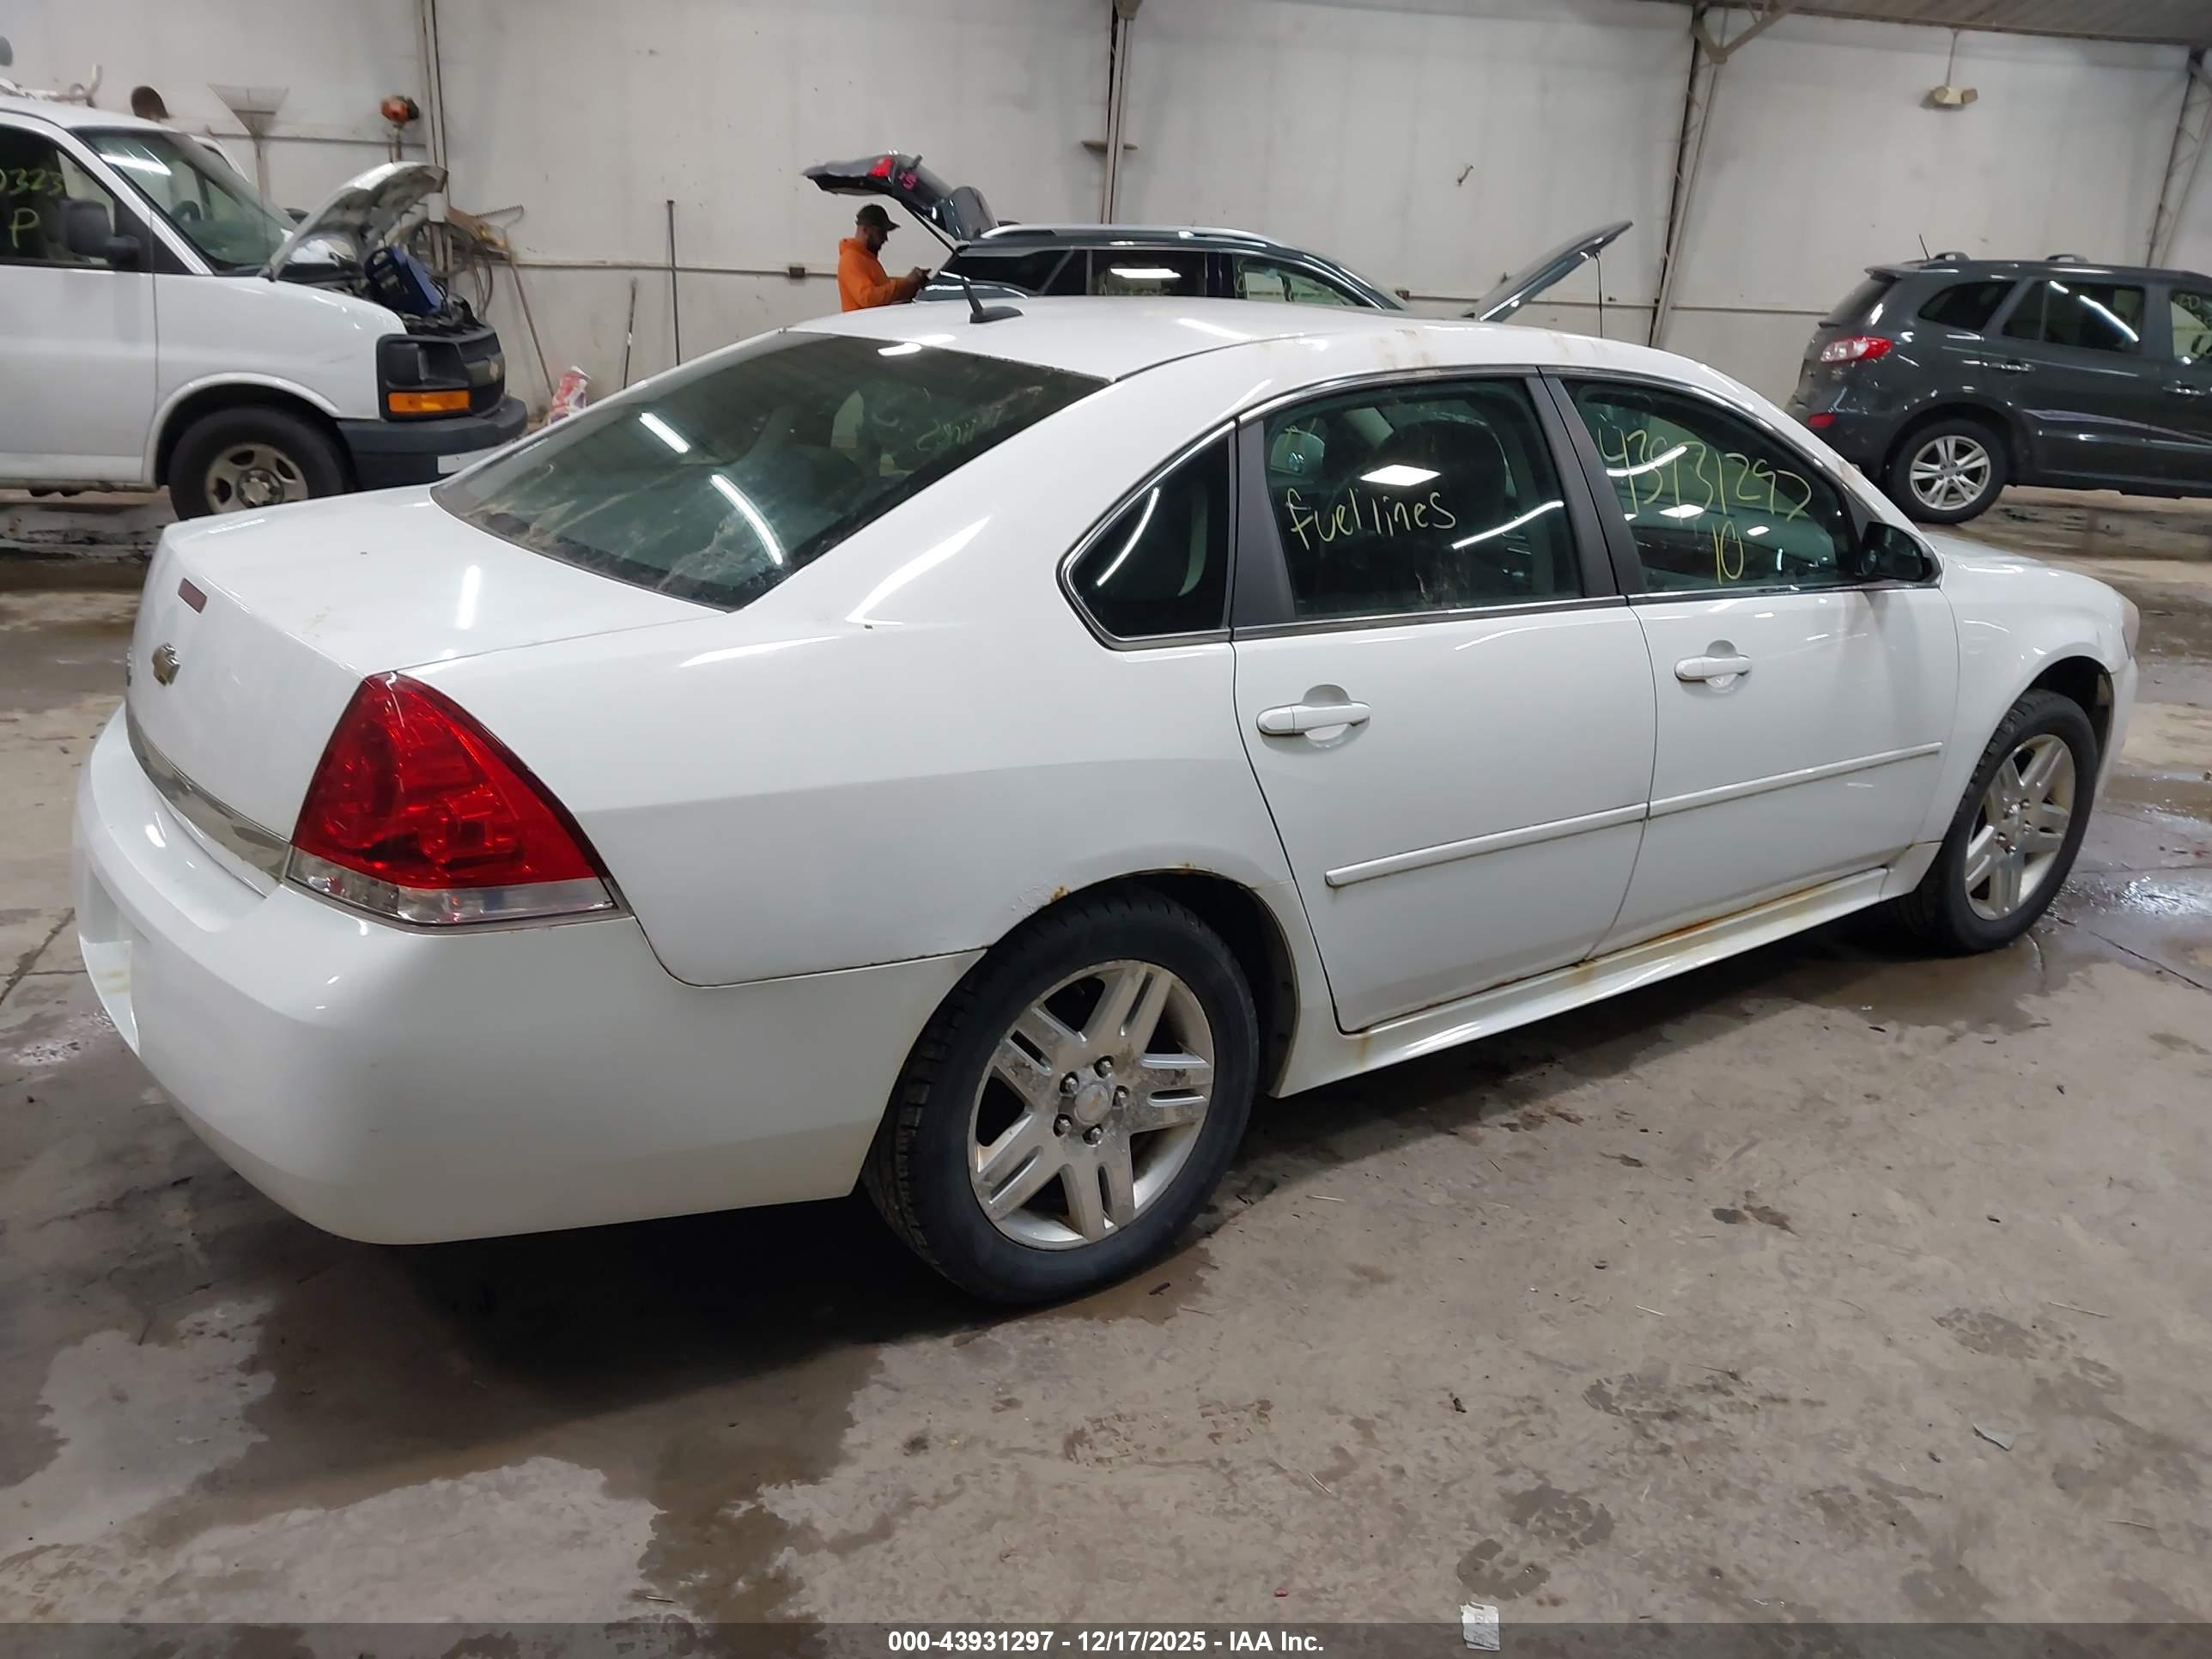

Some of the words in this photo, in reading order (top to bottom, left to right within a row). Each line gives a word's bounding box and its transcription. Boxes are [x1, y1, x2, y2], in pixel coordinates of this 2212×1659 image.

[1285, 488, 1362, 550] fuel
[1371, 492, 1455, 537] lines
[1711, 520, 1744, 584] 10
